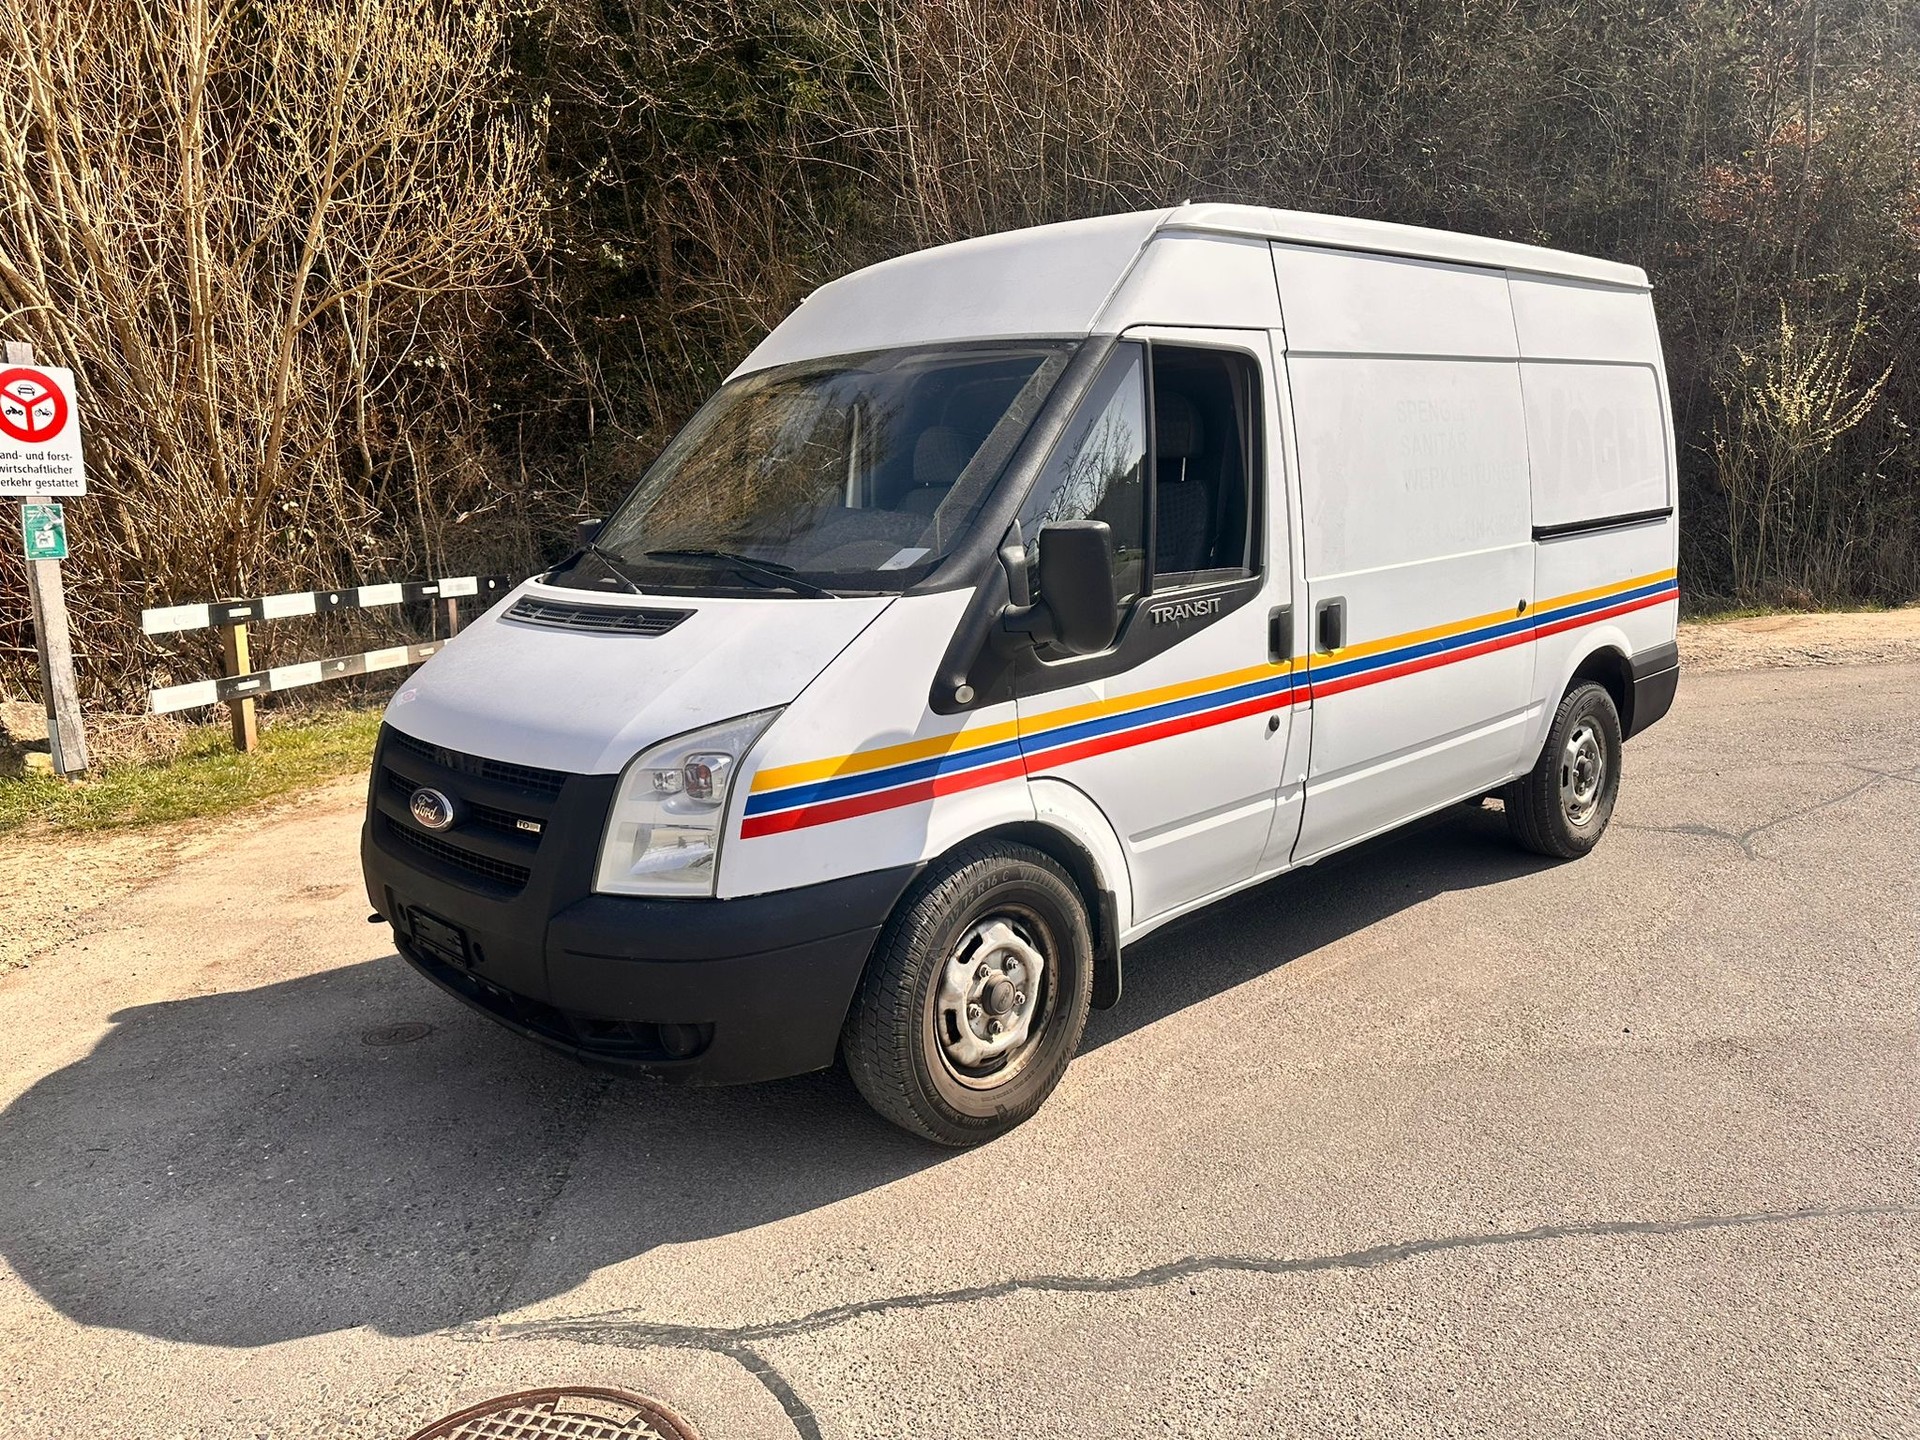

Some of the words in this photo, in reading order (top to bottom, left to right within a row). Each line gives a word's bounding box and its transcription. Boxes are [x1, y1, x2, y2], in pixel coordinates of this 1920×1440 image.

[25, 451, 44, 461] und
[47, 451, 73, 462] forst-
[35, 479, 79, 489] gestattet
[1150, 597, 1221, 624] TRANSIT
[414, 793, 438, 821] Ford
[1002, 869, 1010, 882] C
